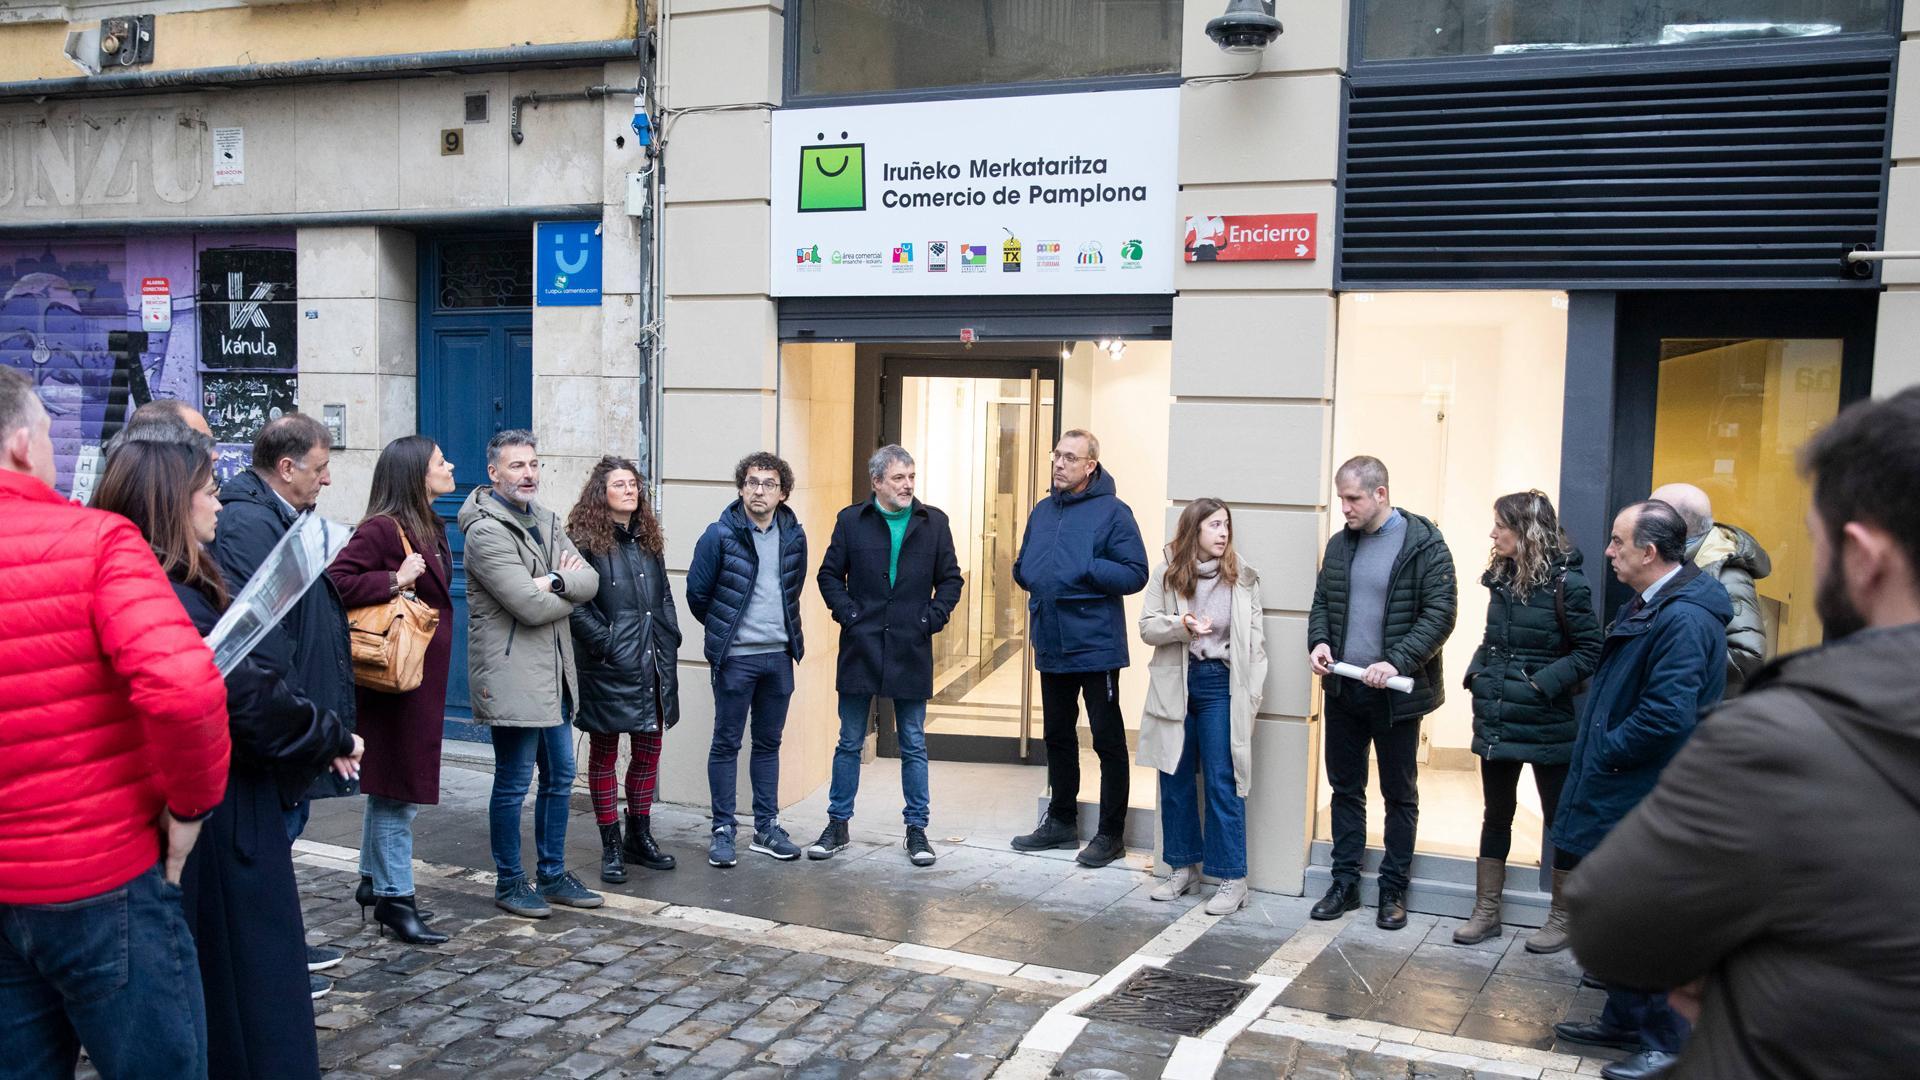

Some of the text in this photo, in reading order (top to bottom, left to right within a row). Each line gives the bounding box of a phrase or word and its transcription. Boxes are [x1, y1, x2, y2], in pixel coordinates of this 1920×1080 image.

[445, 131, 459, 152] 9
[883, 156, 1107, 182] Iruñeko Merkataritza
[882, 184, 1147, 208] Comercio de Pamplona
[1229, 224, 1310, 243] Encierro
[1003, 252, 1019, 262] TX
[221, 330, 277, 357] kánula
